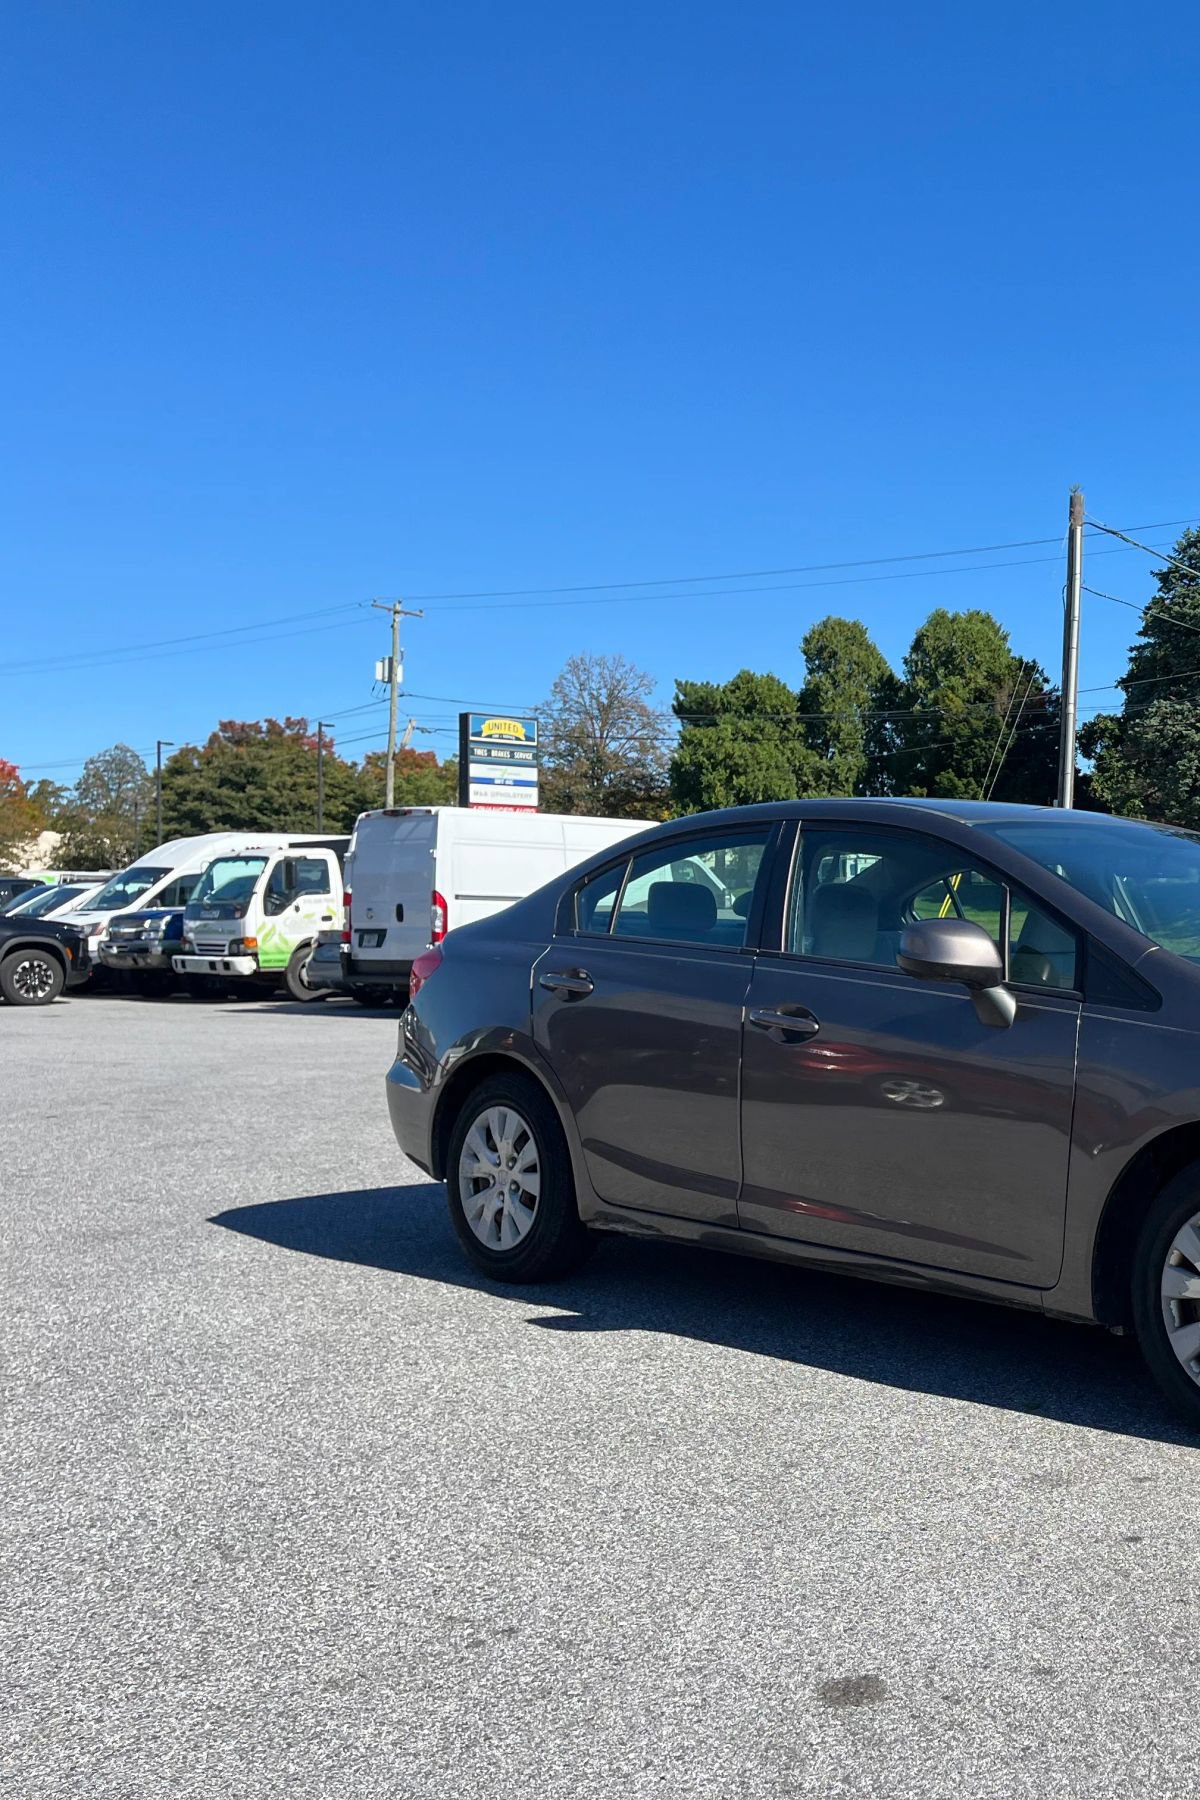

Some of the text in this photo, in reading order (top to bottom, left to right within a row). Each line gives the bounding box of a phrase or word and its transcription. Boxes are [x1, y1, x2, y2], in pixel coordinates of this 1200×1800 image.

[488, 722, 518, 733] UNITED
[474, 748, 533, 760] TIRES BRAKES SERVICE
